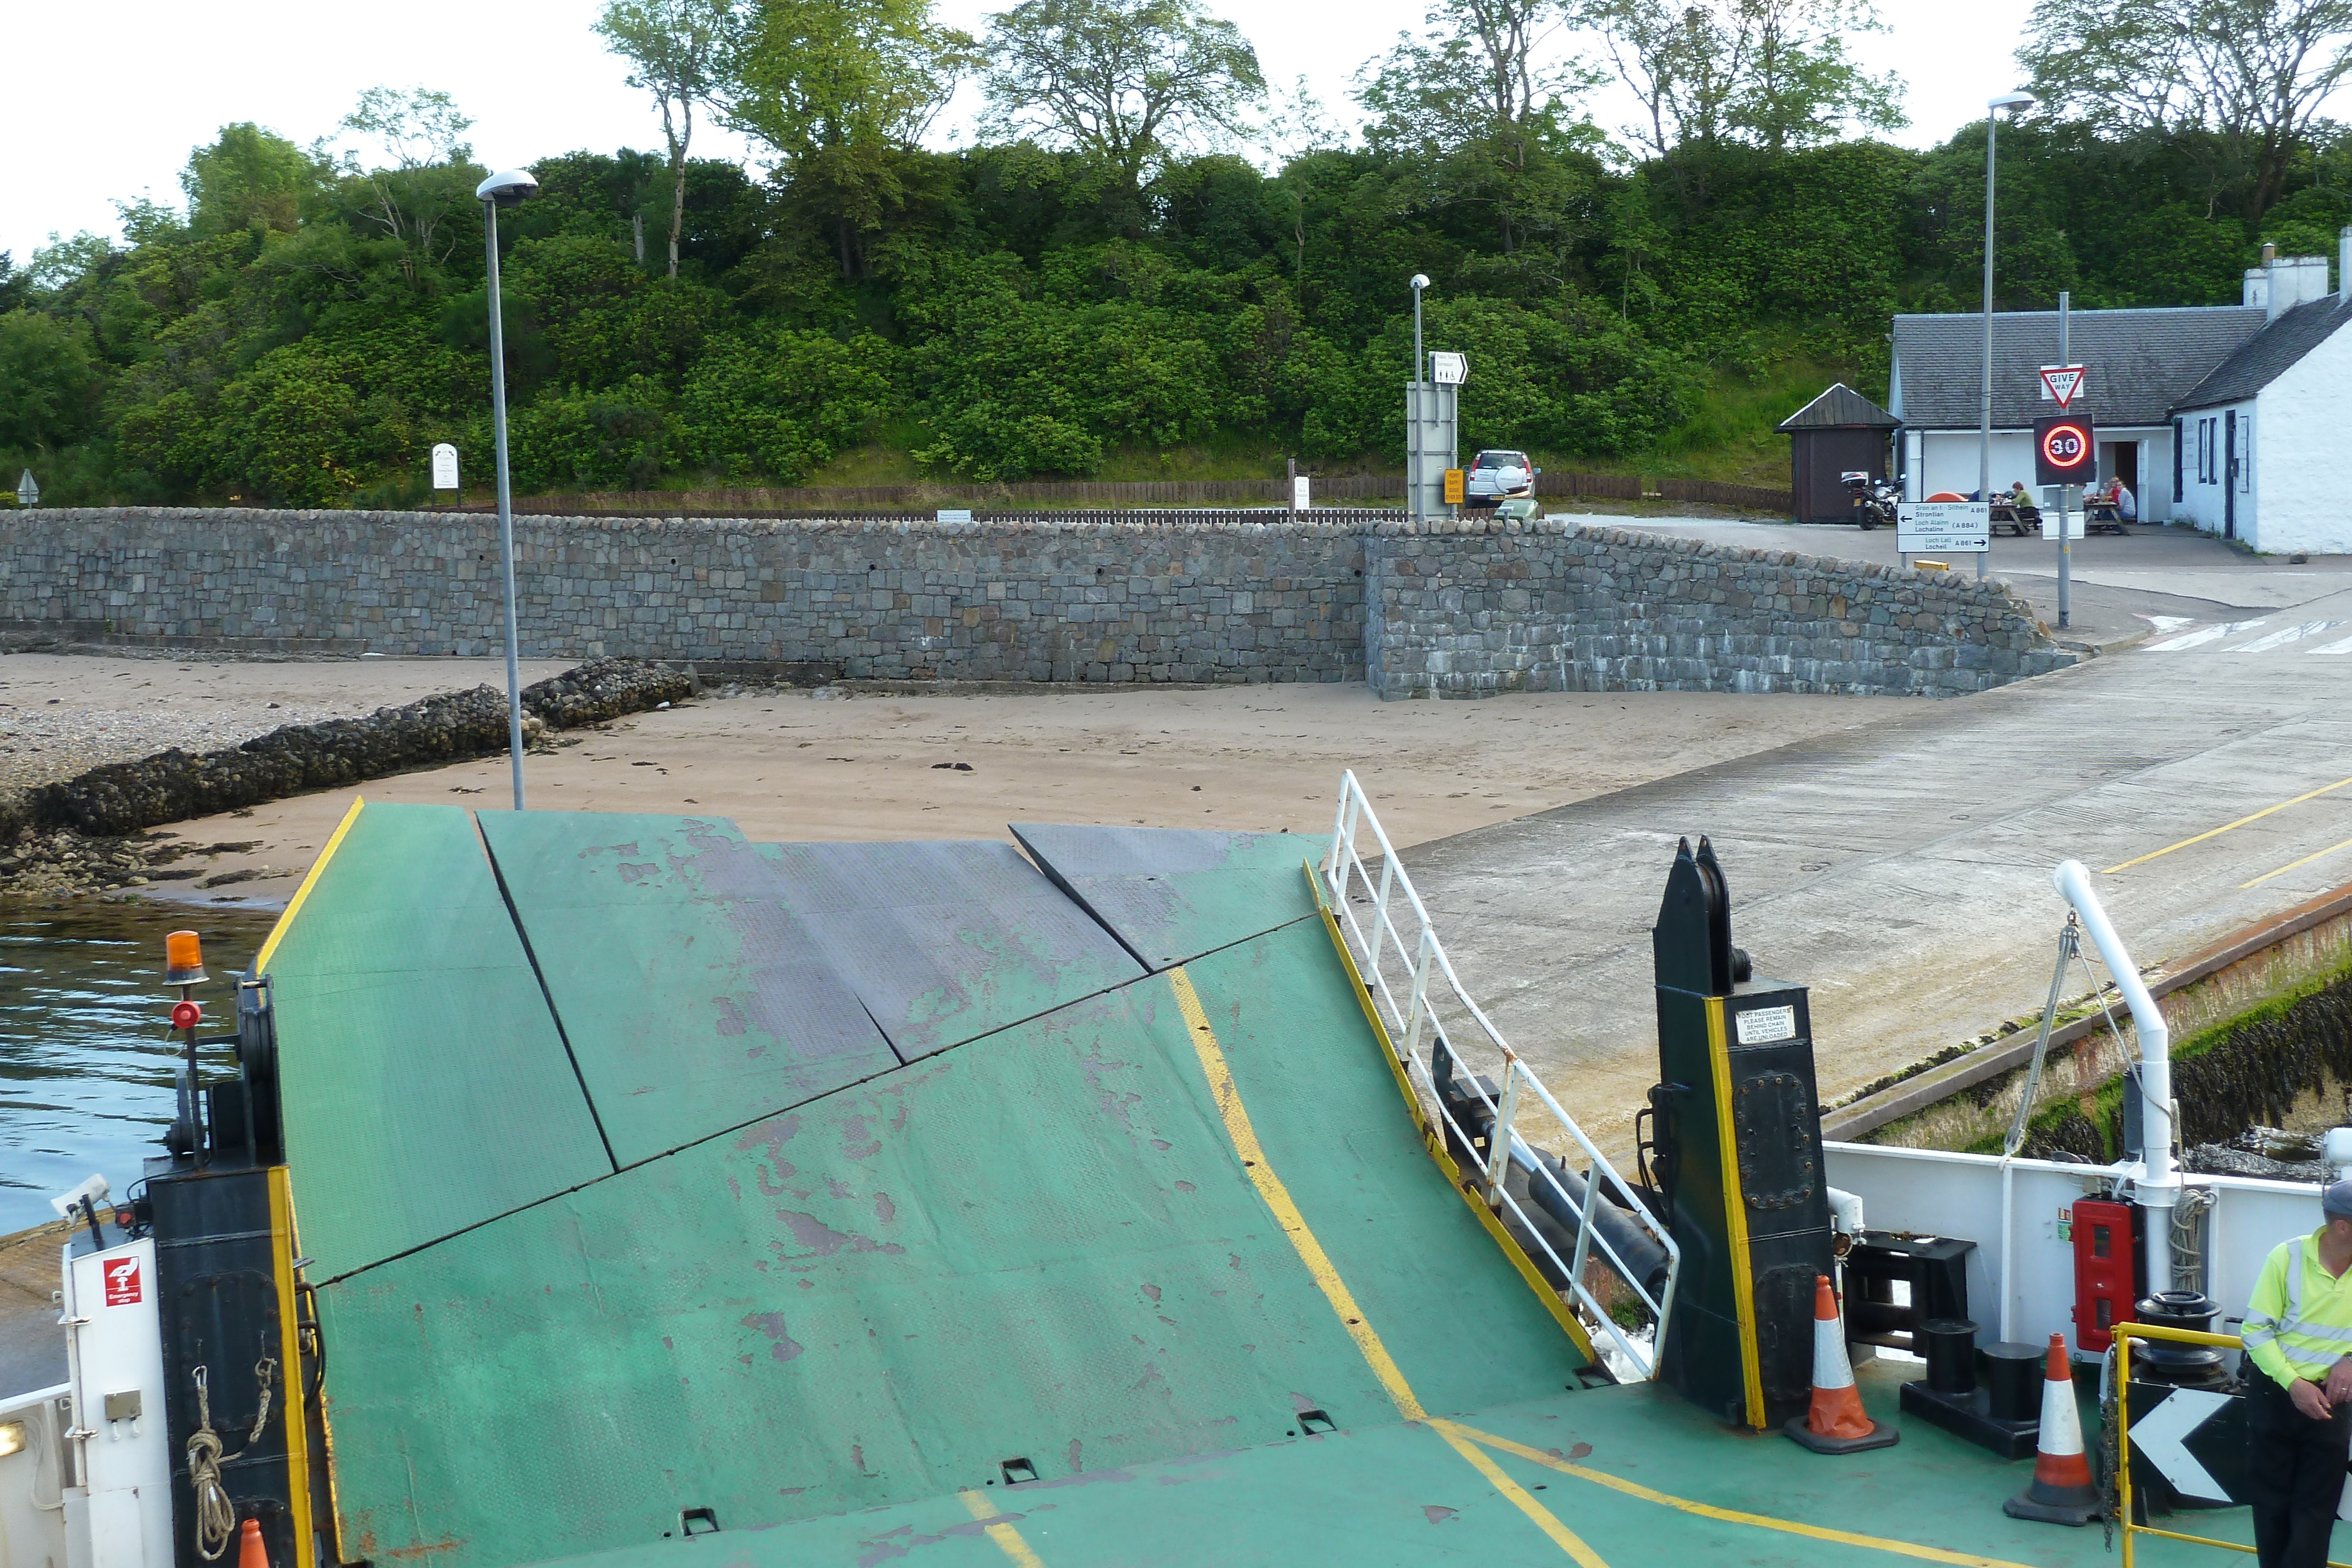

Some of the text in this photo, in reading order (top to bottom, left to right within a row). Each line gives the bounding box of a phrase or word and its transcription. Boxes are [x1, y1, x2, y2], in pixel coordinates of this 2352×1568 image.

[2050, 374, 2074, 382] GIVE
[2050, 438, 2079, 455] 30
[1755, 1008, 1790, 1017] PASSENGERS
[1759, 1032, 1788, 1041] UNLOADED
